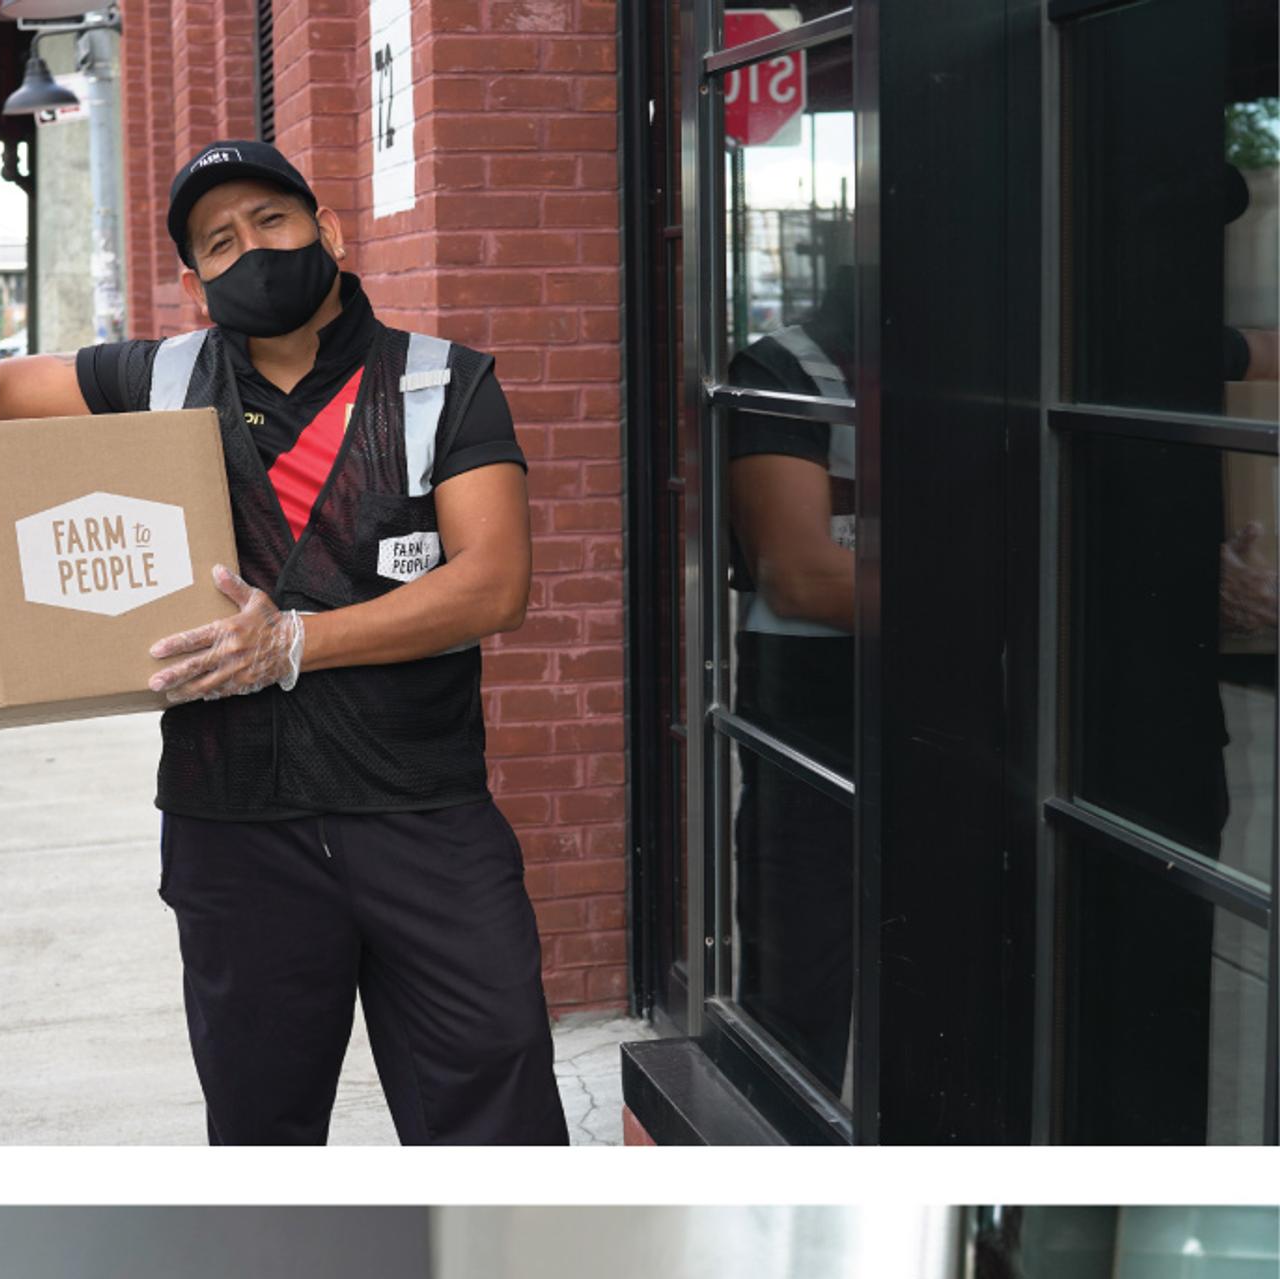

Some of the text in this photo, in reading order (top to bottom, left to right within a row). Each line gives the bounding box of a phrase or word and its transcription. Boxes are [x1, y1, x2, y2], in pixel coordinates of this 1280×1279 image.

[52, 514, 152, 556] FARM to
[57, 552, 159, 596] PEOPLE
